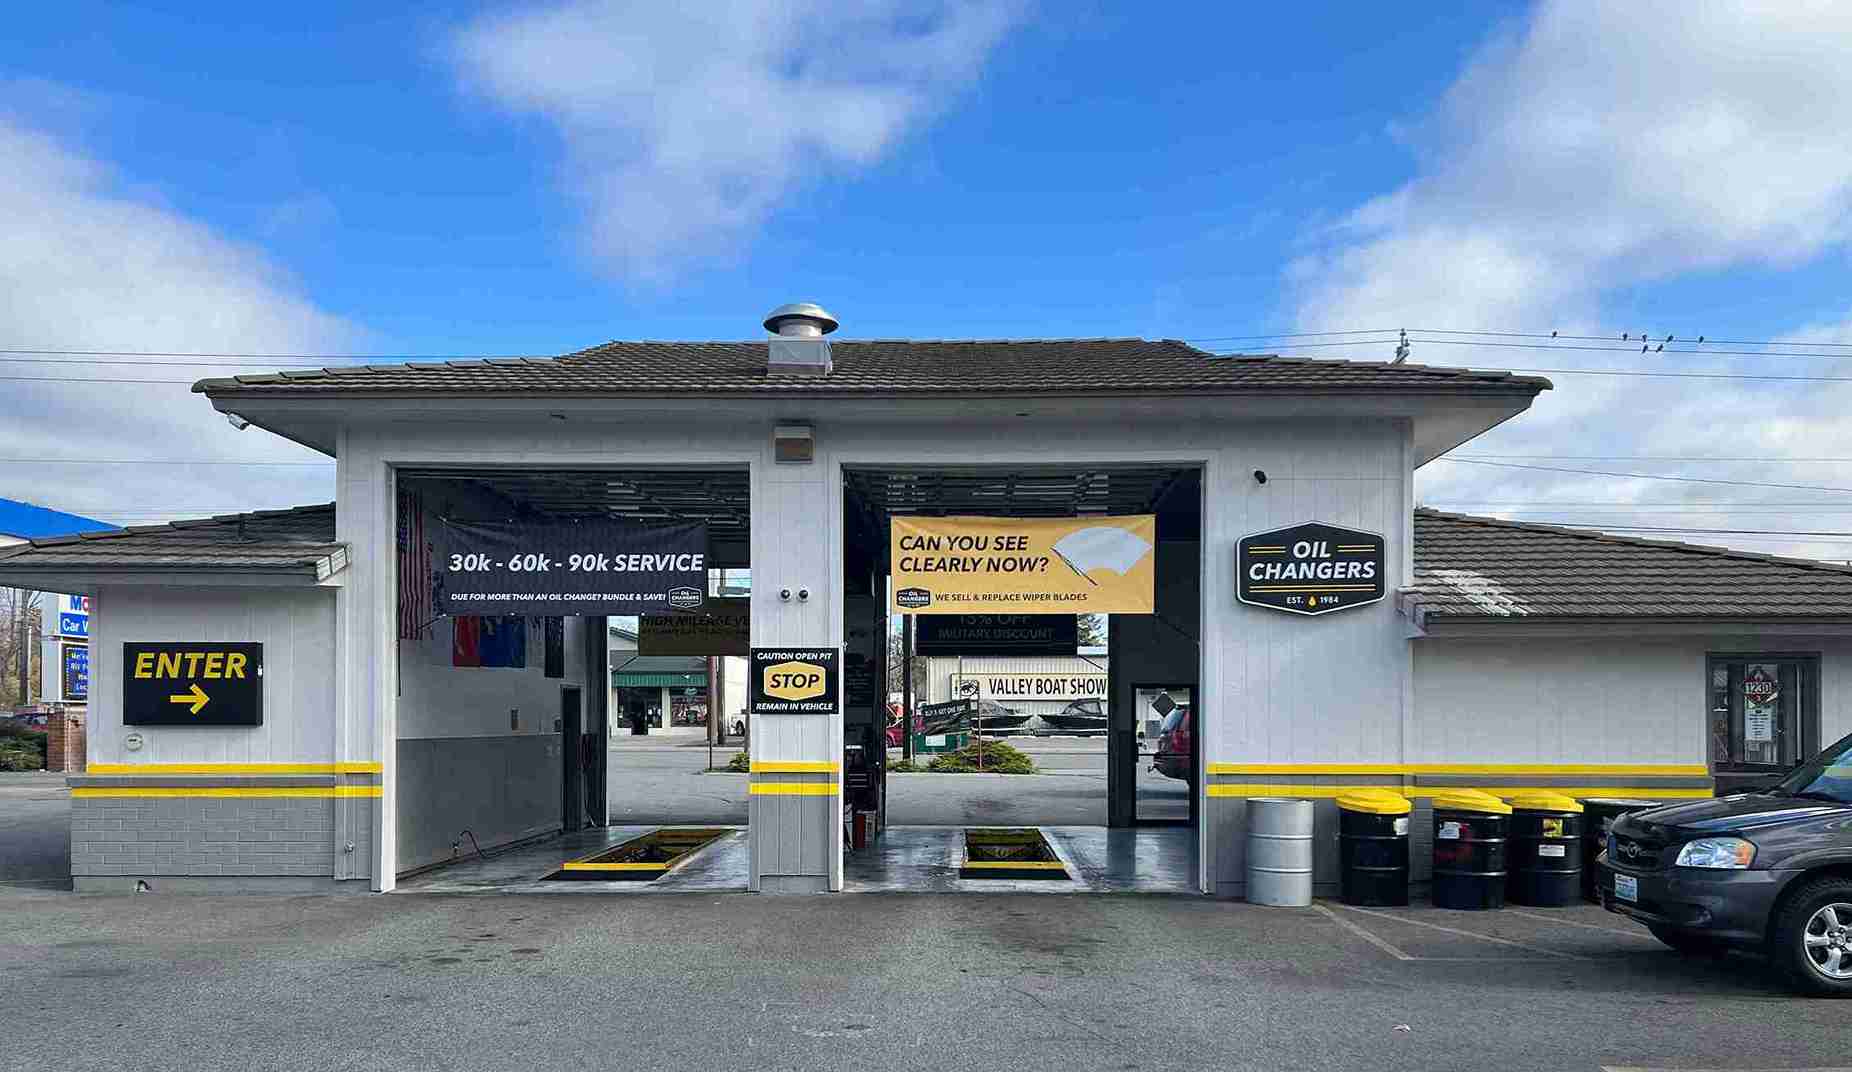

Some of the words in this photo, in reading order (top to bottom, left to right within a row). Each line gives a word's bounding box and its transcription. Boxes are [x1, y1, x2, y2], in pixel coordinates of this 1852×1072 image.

[899, 536, 941, 551] CAN
[946, 535, 991, 551] YOU
[993, 535, 1028, 550] SEE
[1293, 541, 1331, 558] OIL
[448, 553, 492, 571] 30k
[508, 553, 551, 571] 60k
[568, 553, 610, 571] 90k
[613, 553, 704, 571] SERVICE
[899, 557, 984, 573] CLEARLY
[986, 556, 1049, 572] NOW?
[1249, 561, 1376, 580] CHANGERS
[951, 593, 970, 601] SELL
[982, 593, 1020, 601] REPLACE
[1022, 593, 1051, 601] WIPER
[1053, 593, 1088, 601] BLADES
[1286, 596, 1305, 604] EST.
[62, 618, 80, 632] Car
[757, 652, 794, 660] CAUTION
[795, 652, 818, 660] OPEN
[819, 652, 832, 660] PIT
[134, 652, 247, 679] ENTER
[770, 673, 820, 688] STOP
[989, 678, 1033, 695] VALLEY
[1036, 678, 1068, 695] BOAT
